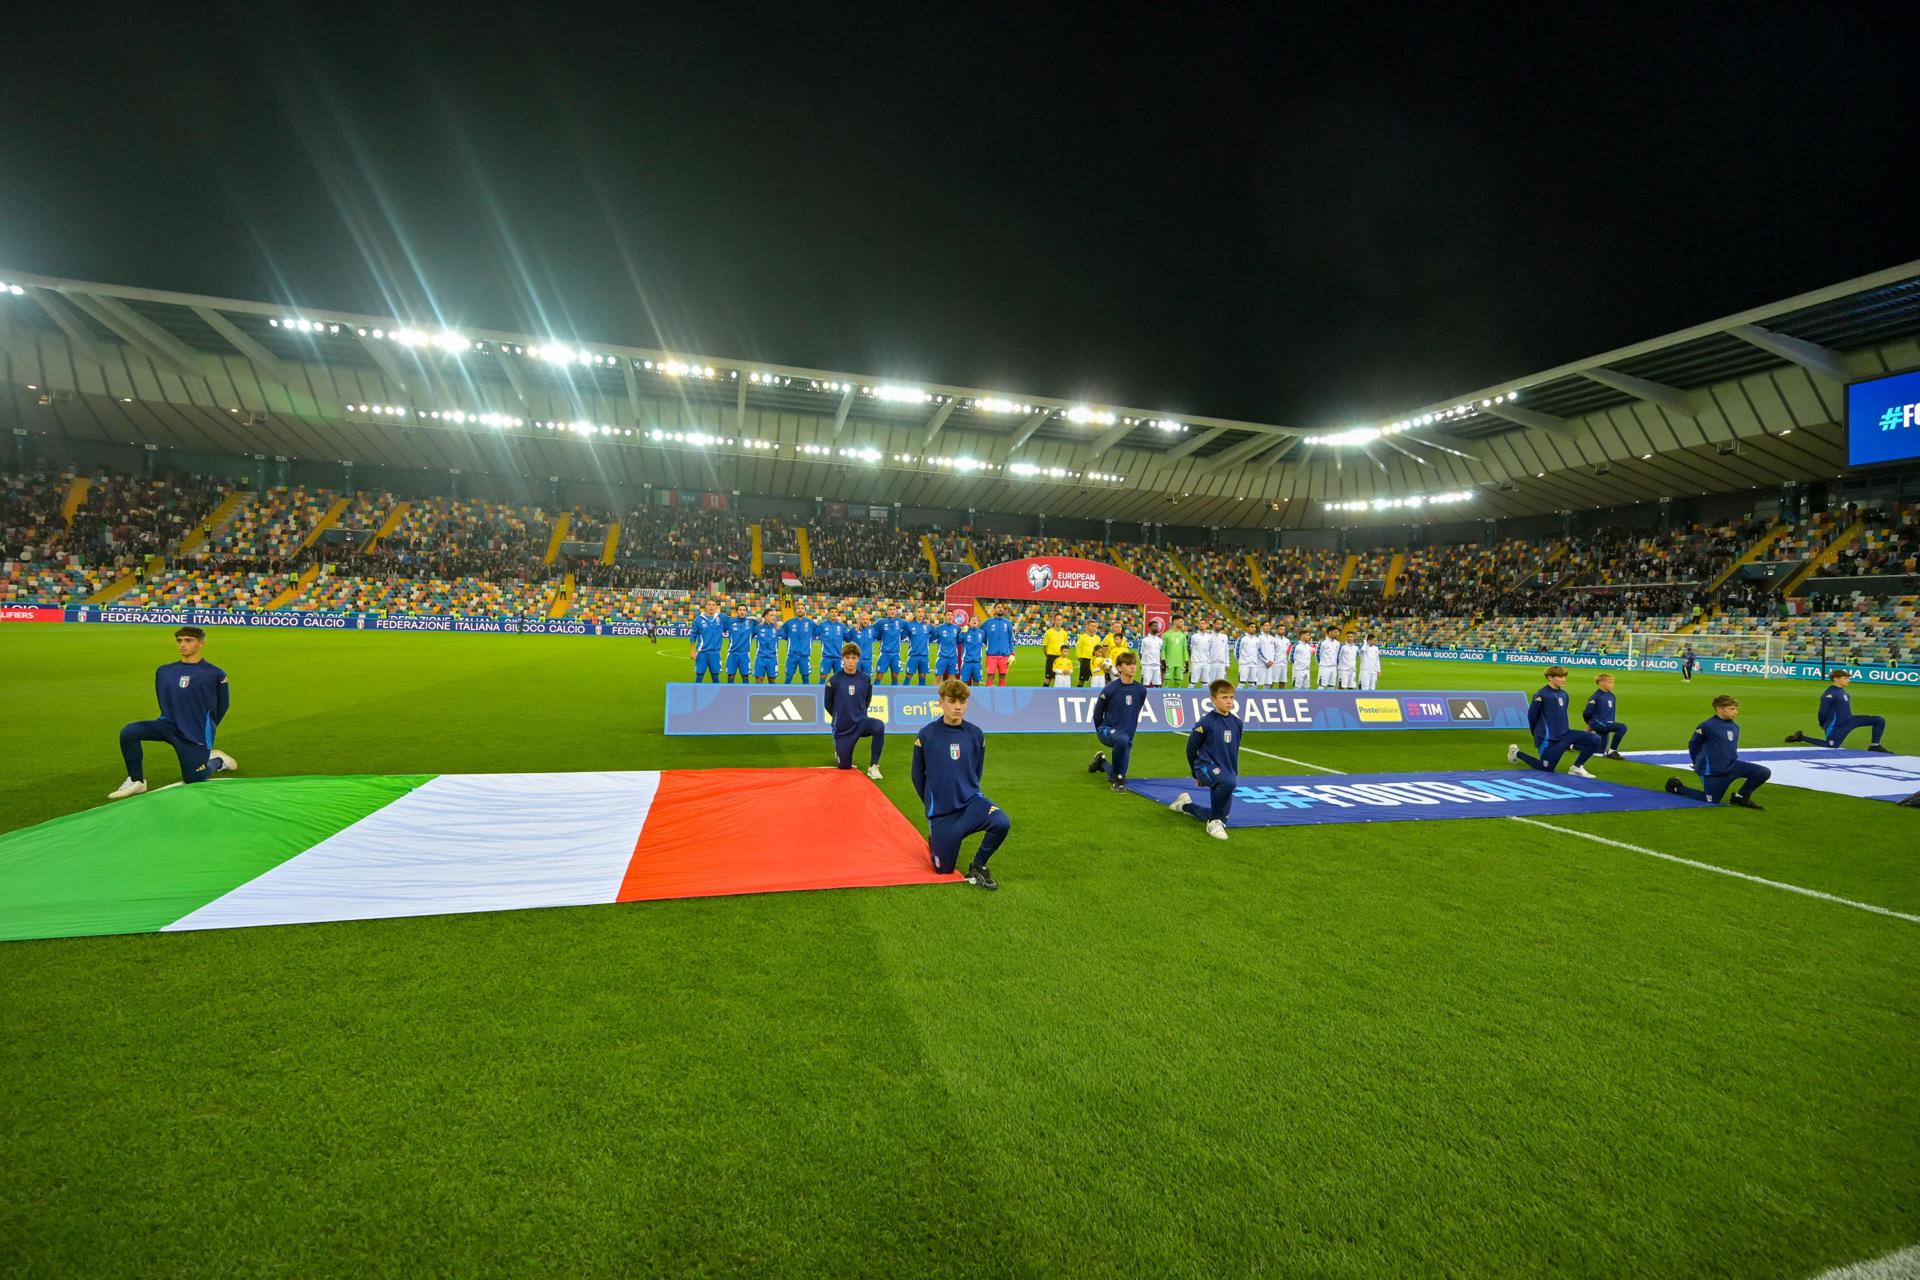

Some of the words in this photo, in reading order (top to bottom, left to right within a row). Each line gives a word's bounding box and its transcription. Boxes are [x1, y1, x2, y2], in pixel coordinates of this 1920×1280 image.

[1057, 571, 1096, 581] EUROPEAN
[1052, 579, 1101, 590] QUALIFIERS
[101, 612, 188, 624] FEDERAZIONE
[193, 614, 246, 625] ITALIANA
[251, 616, 298, 626] GIUOCO
[303, 617, 345, 628] CALCIO
[376, 619, 450, 631] FEDERAZIONE
[455, 621, 500, 632] ITALIANA
[549, 624, 586, 634] CALCIO
[612, 627, 676, 636] FEDERAIONE
[1407, 650, 1432, 658] ITALIANA
[1433, 651, 1457, 659] GIUOCO
[1460, 652, 1484, 660] CALCIO
[1506, 654, 1557, 664] FEDERAZIONE
[1560, 656, 1597, 666] ITALIANA
[1641, 660, 1678, 669] CALCIO
[1714, 662, 1796, 675] FEDERAZIONE
[1869, 670, 1920, 682] GIUOC
[903, 702, 927, 716] eni
[1058, 697, 1158, 723] ITAA
[1419, 703, 1443, 716] TIM
[1232, 778, 1614, 809] #FOOTBALL
